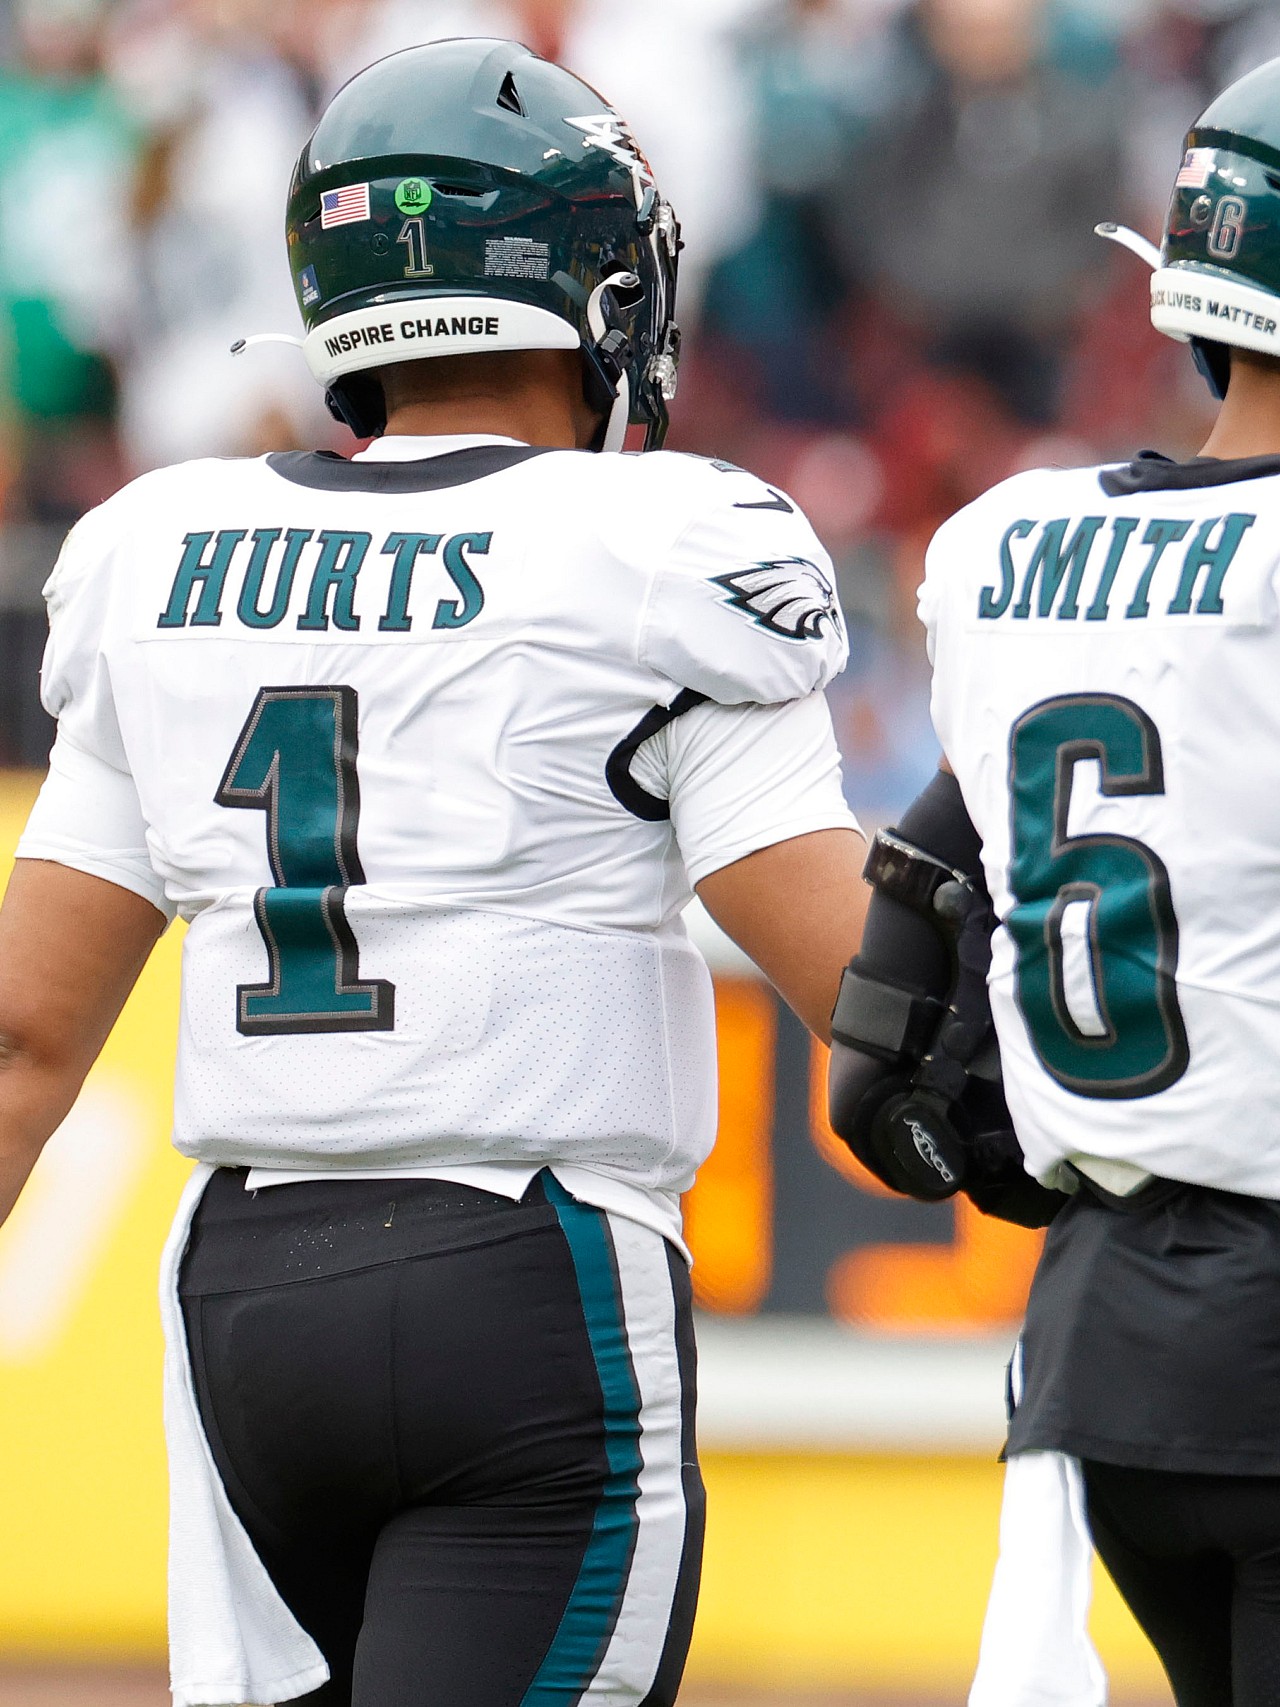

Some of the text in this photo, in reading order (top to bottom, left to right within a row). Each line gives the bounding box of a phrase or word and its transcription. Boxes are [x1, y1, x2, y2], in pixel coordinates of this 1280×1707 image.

[404, 188, 422, 200] NFL
[1207, 194, 1246, 259] 6
[396, 217, 434, 279] 1
[324, 316, 499, 358] INSPIRE CHANGE
[1167, 290, 1202, 312] LIVES
[1205, 299, 1278, 335] MATTER
[156, 527, 494, 632] HURTS
[978, 512, 1258, 622] SMITH
[213, 685, 396, 1037] 1
[1003, 691, 1190, 1101] 6
[903, 1118, 955, 1183] DONJOY
